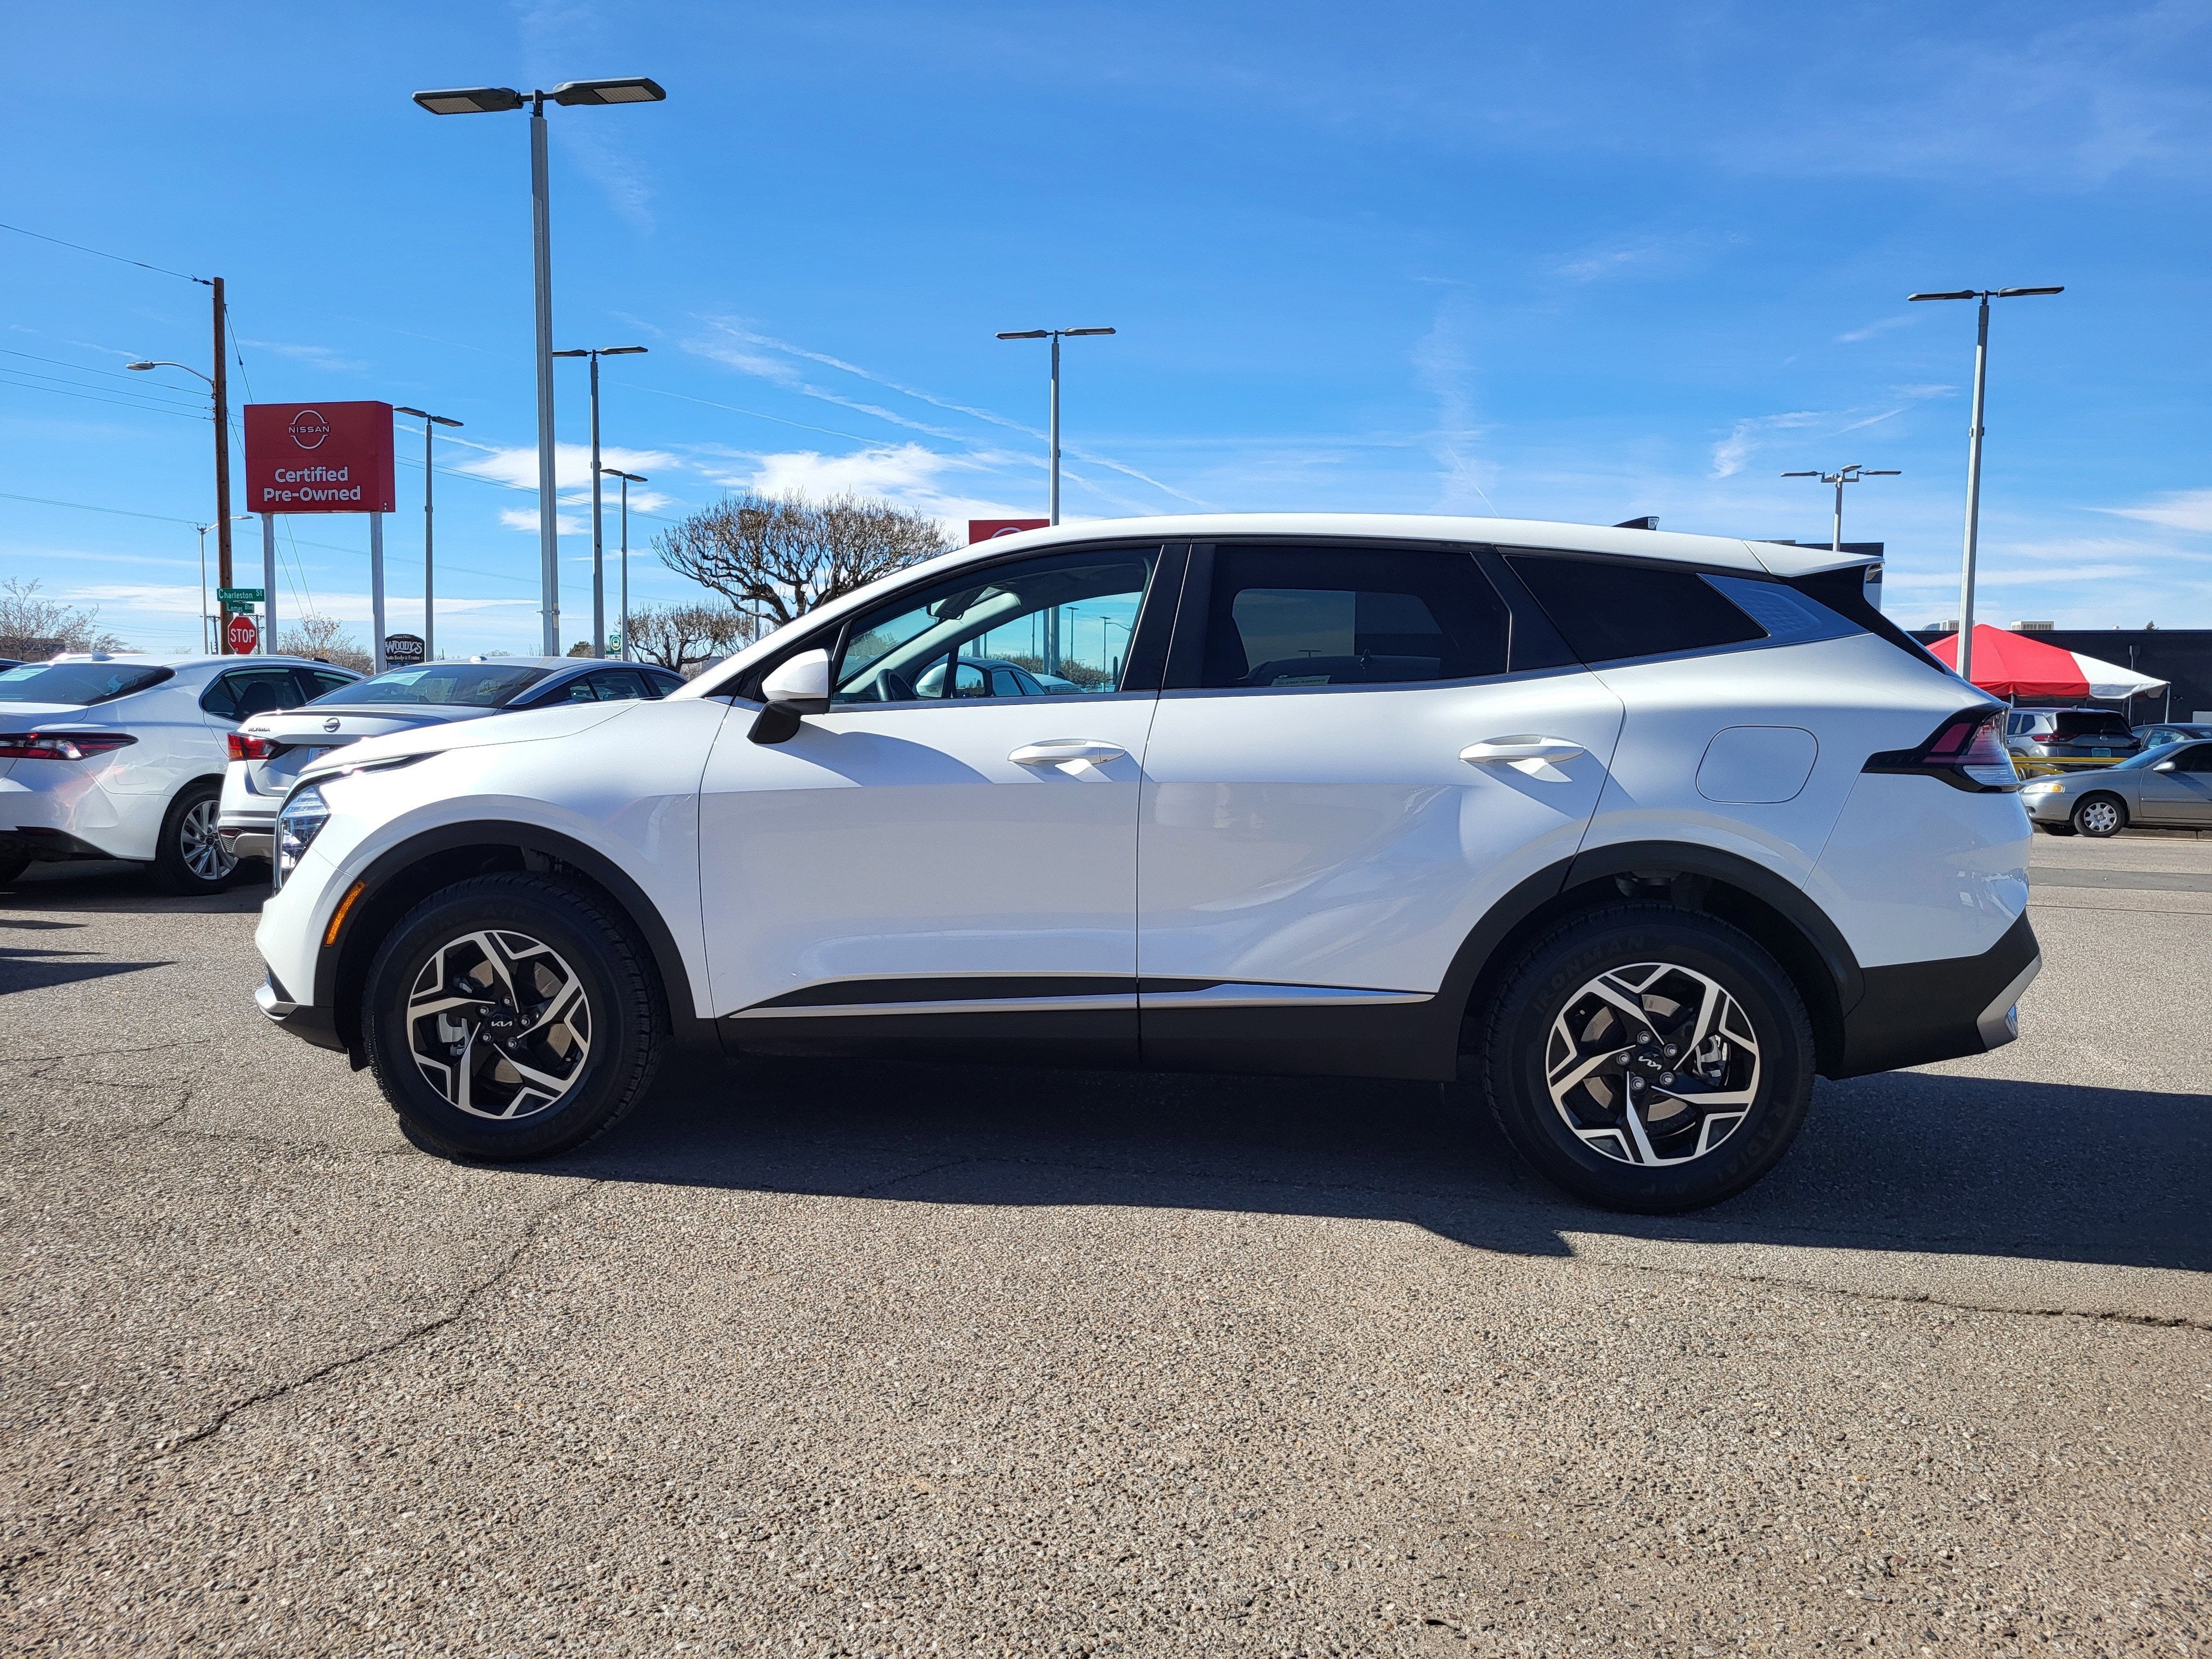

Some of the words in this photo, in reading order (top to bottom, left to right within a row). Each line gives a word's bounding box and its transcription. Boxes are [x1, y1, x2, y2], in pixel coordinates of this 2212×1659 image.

[289, 425, 330, 434] NISSAN
[275, 467, 348, 483] Certified
[263, 486, 361, 502] Pre-Owned
[218, 589, 253, 599] Charleston
[227, 603, 243, 612] Lomas
[230, 628, 254, 643] STOP
[385, 640, 422, 654] WOODY'S
